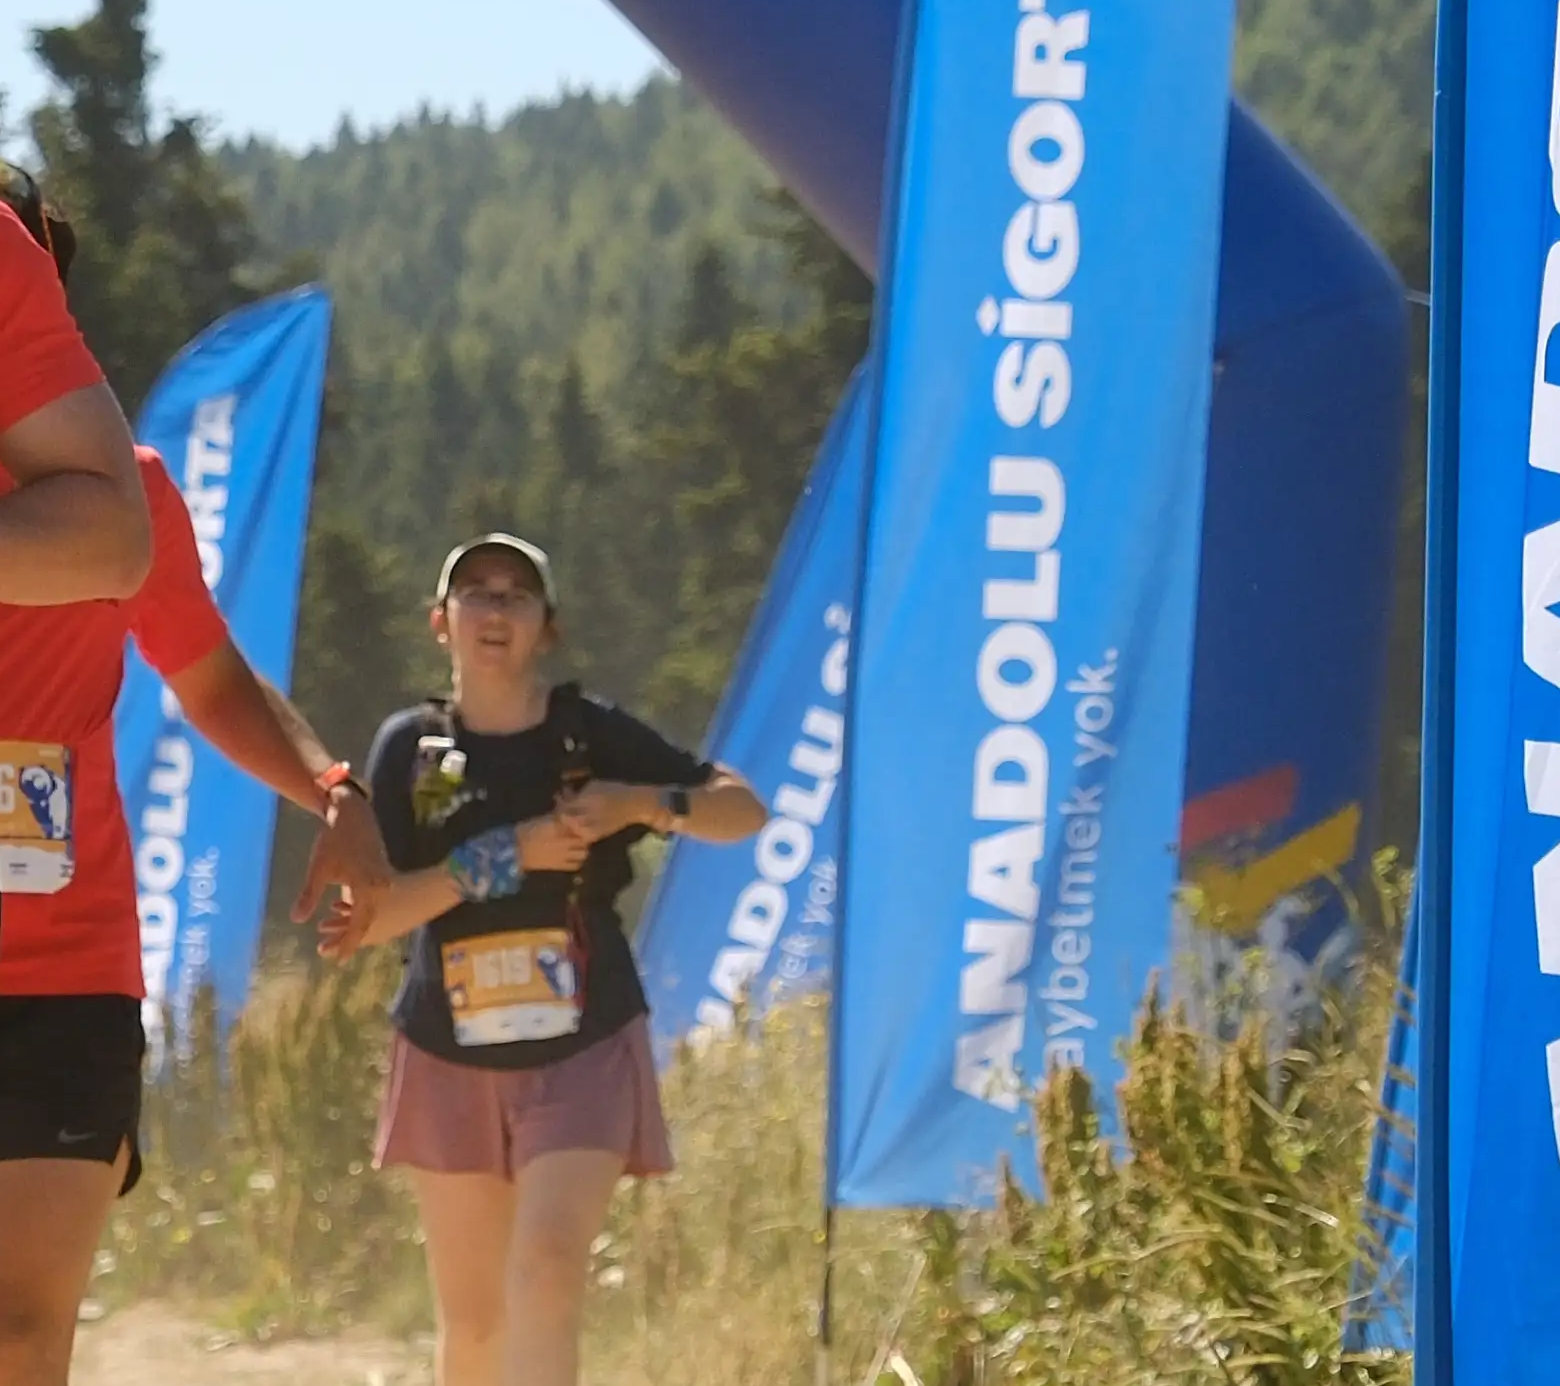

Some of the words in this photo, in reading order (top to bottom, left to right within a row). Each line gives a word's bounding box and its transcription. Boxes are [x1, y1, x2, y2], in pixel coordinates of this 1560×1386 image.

[952, 455, 1067, 1113] ANADOLU
[1065, 646, 1120, 768] yok.
[1037, 782, 1105, 1073] aybetmek
